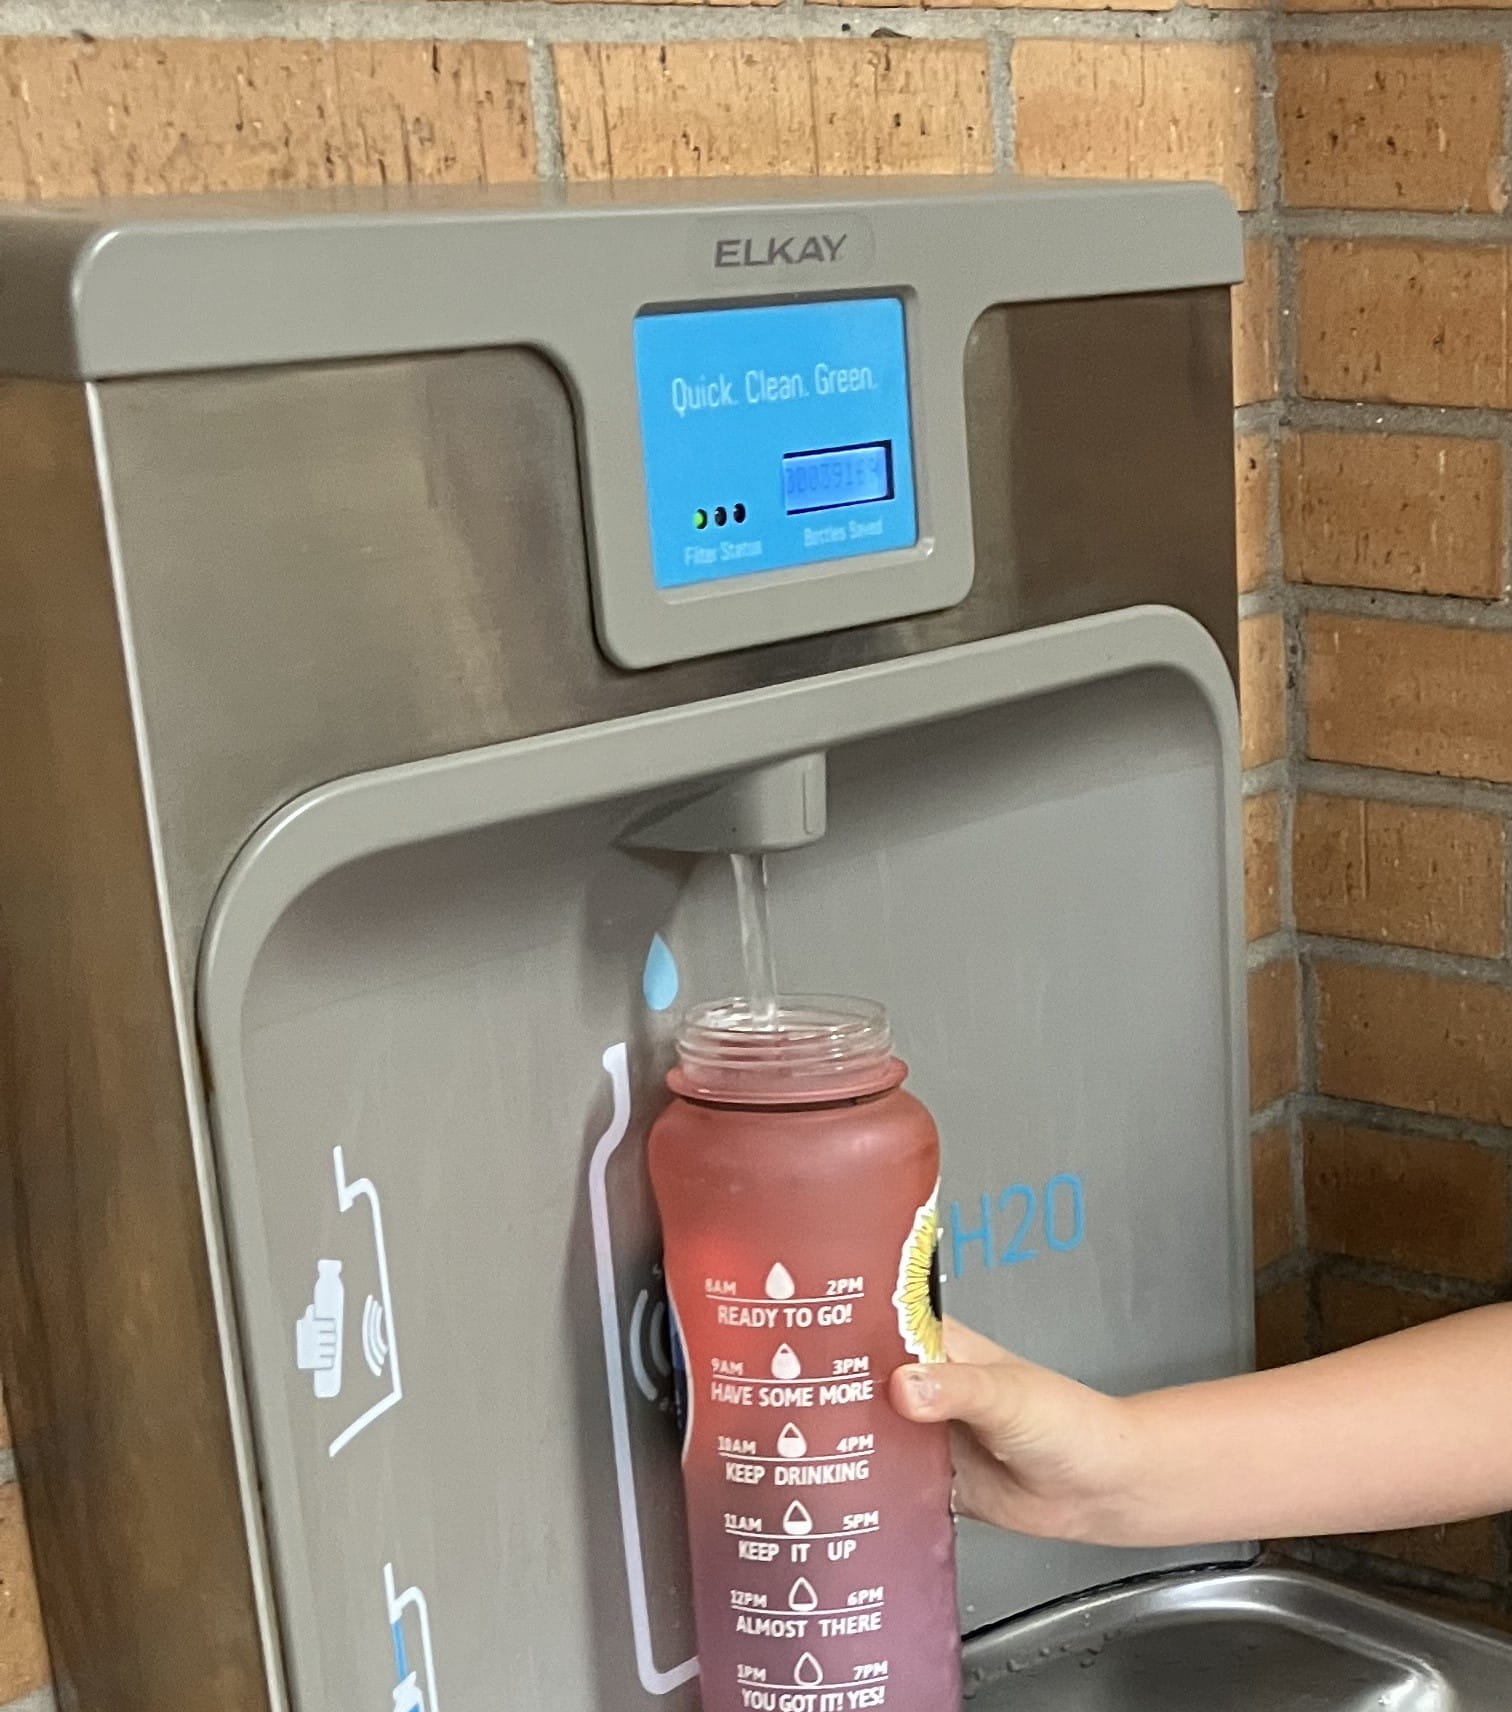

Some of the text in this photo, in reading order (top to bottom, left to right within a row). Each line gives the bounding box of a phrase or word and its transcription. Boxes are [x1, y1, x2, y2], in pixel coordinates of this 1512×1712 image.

[714, 233, 847, 268] ELKAY
[671, 362, 878, 418] Quick. Clean. Green.
[826, 1276, 864, 1296] 2PM
[717, 1303, 853, 1329] READY TO GO!
[711, 1355, 869, 1375] 9AM 3PM
[711, 1379, 874, 1408] HAVE SOME MORE
[717, 1433, 875, 1455] 10AM 4PM
[725, 1459, 870, 1486] KEEP DRINKING
[723, 1510, 879, 1532] 11AM 5PM
[738, 1539, 857, 1563] KEEP IT UP
[730, 1586, 884, 1608] 12PM 6PM
[736, 1611, 882, 1639] ALMOST THERE
[736, 1660, 889, 1682] 1PM 7PM
[741, 1687, 776, 1712] YOU
[819, 1691, 844, 1712] IT!
[847, 1685, 886, 1710] YES!
